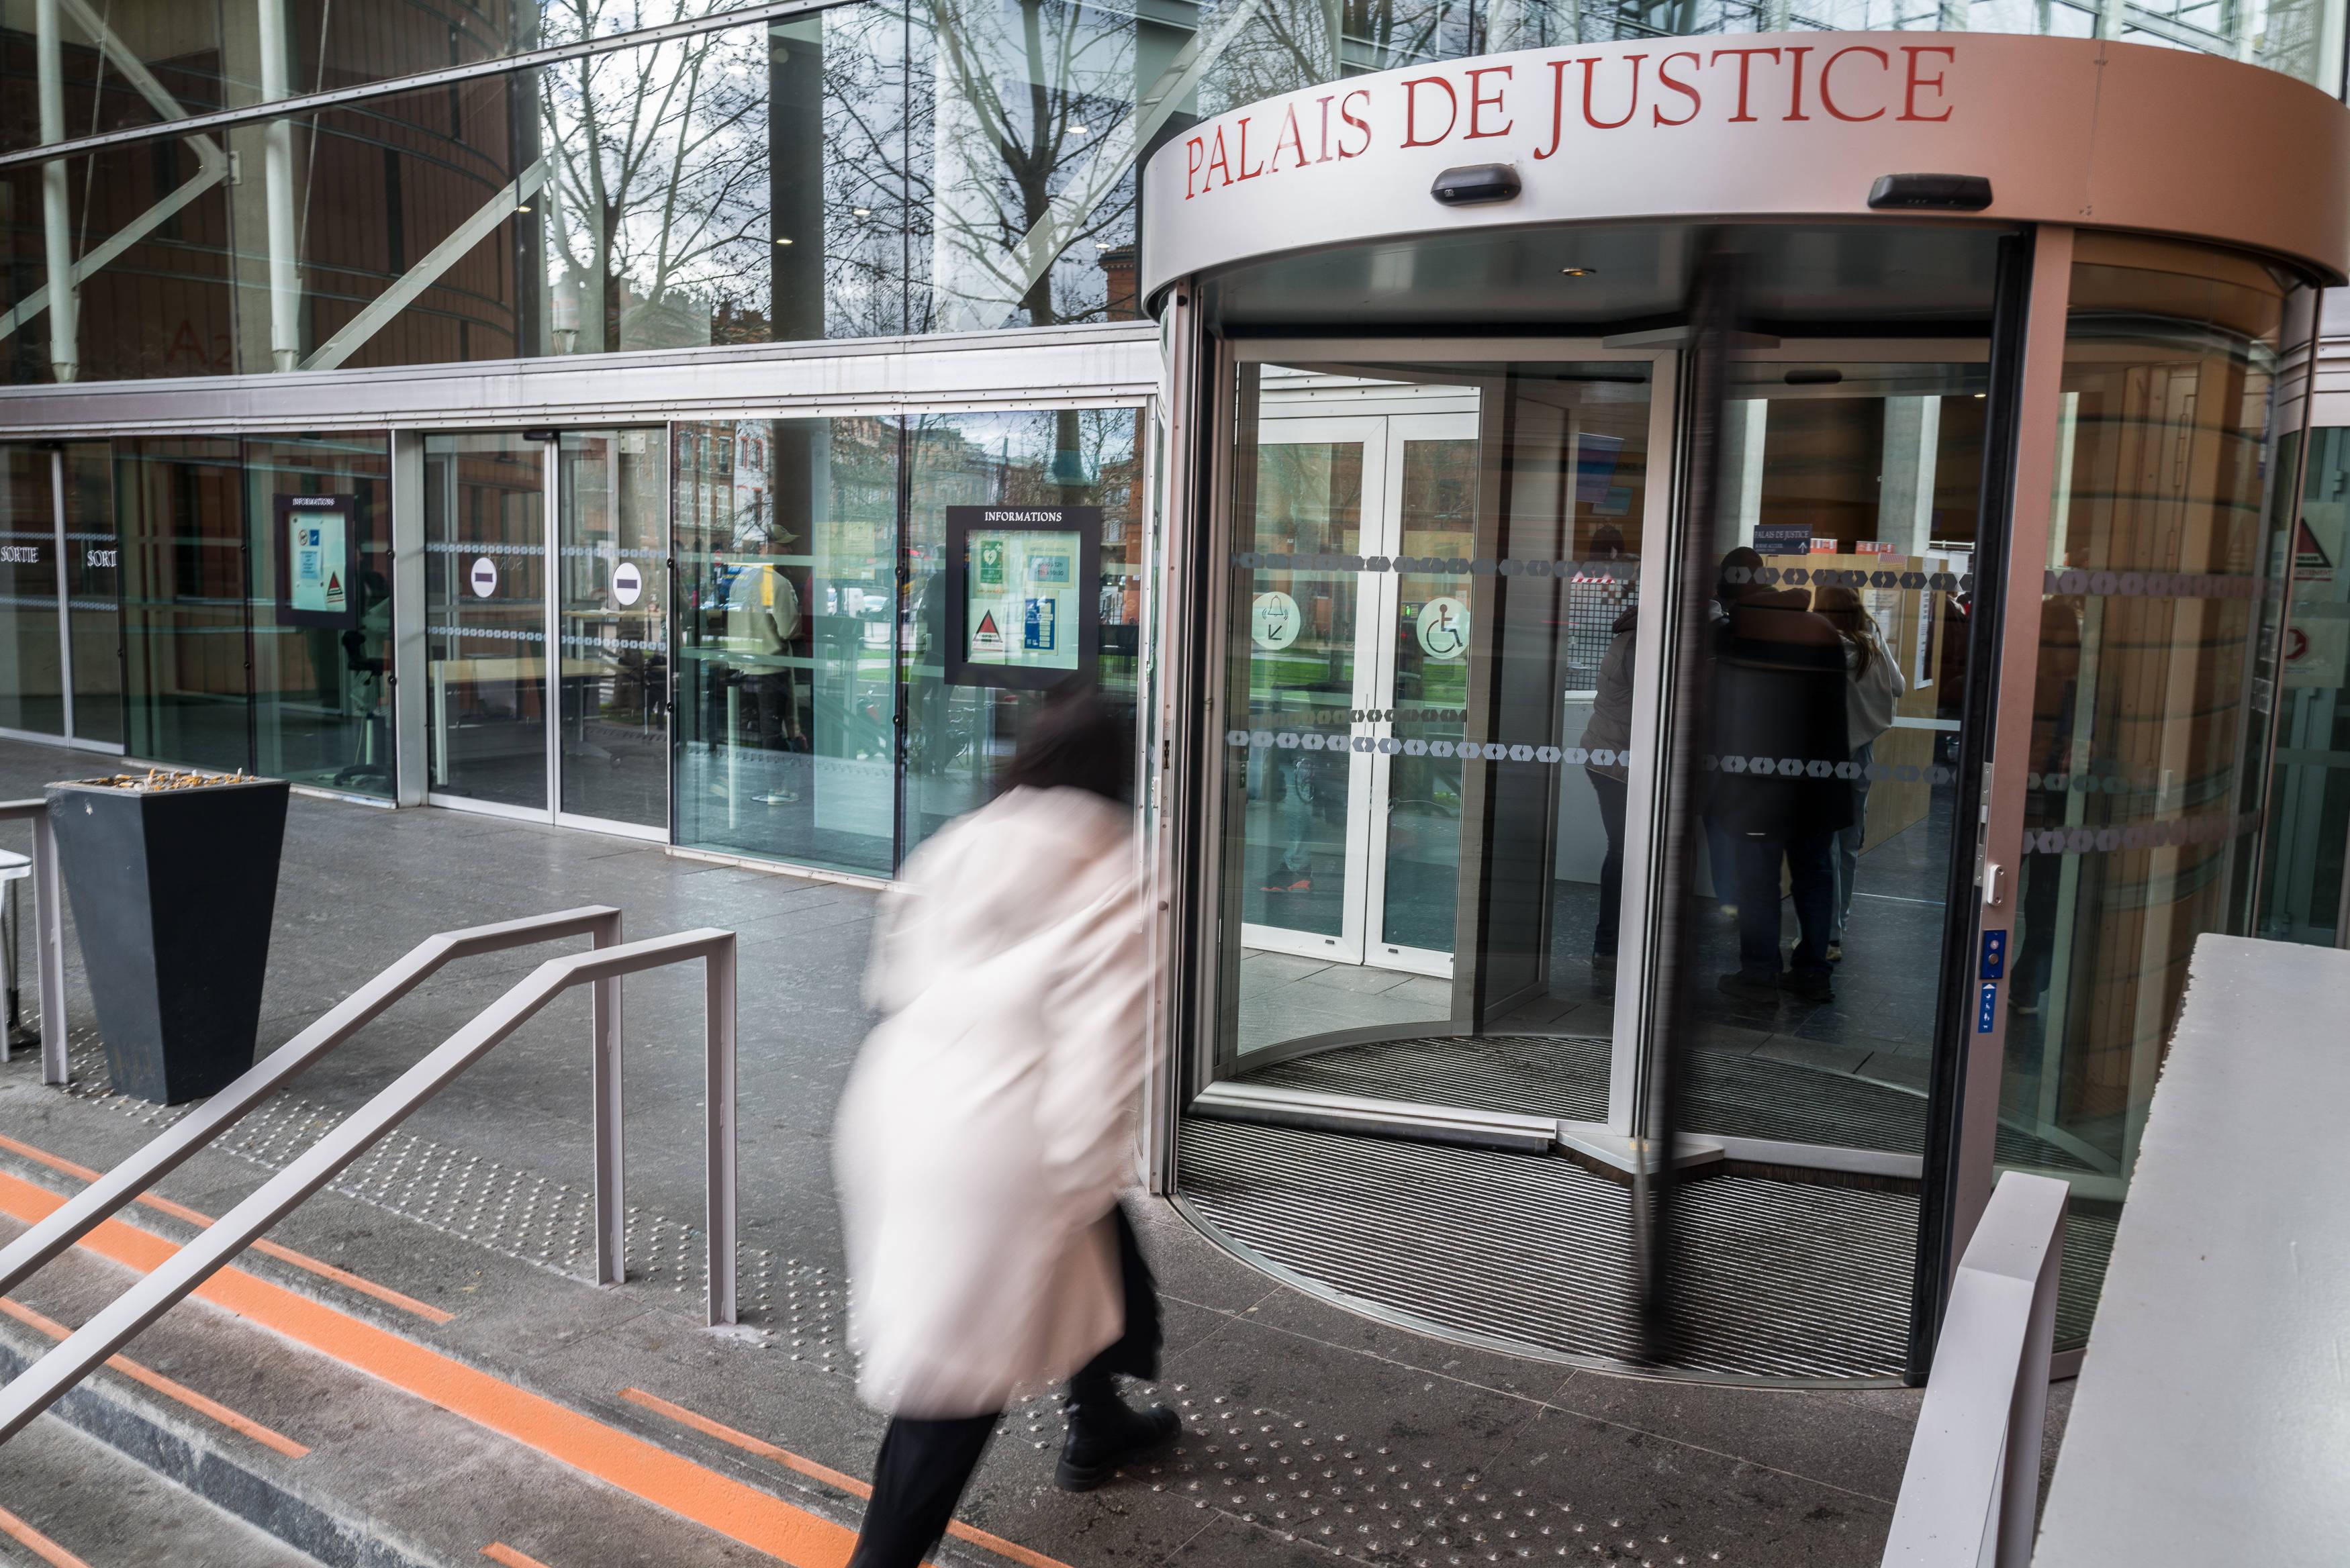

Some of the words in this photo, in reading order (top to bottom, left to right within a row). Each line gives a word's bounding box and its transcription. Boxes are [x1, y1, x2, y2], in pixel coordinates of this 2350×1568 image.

[1185, 89, 1372, 201] PALAIS
[1400, 65, 1514, 149] DE
[1533, 46, 1957, 160] JUSTICE
[984, 511, 1062, 522] INFORMATIONS
[1754, 531, 1775, 539] PALAIS
[1783, 530, 1809, 540] JUSTICE
[0, 546, 40, 563] SORTIE
